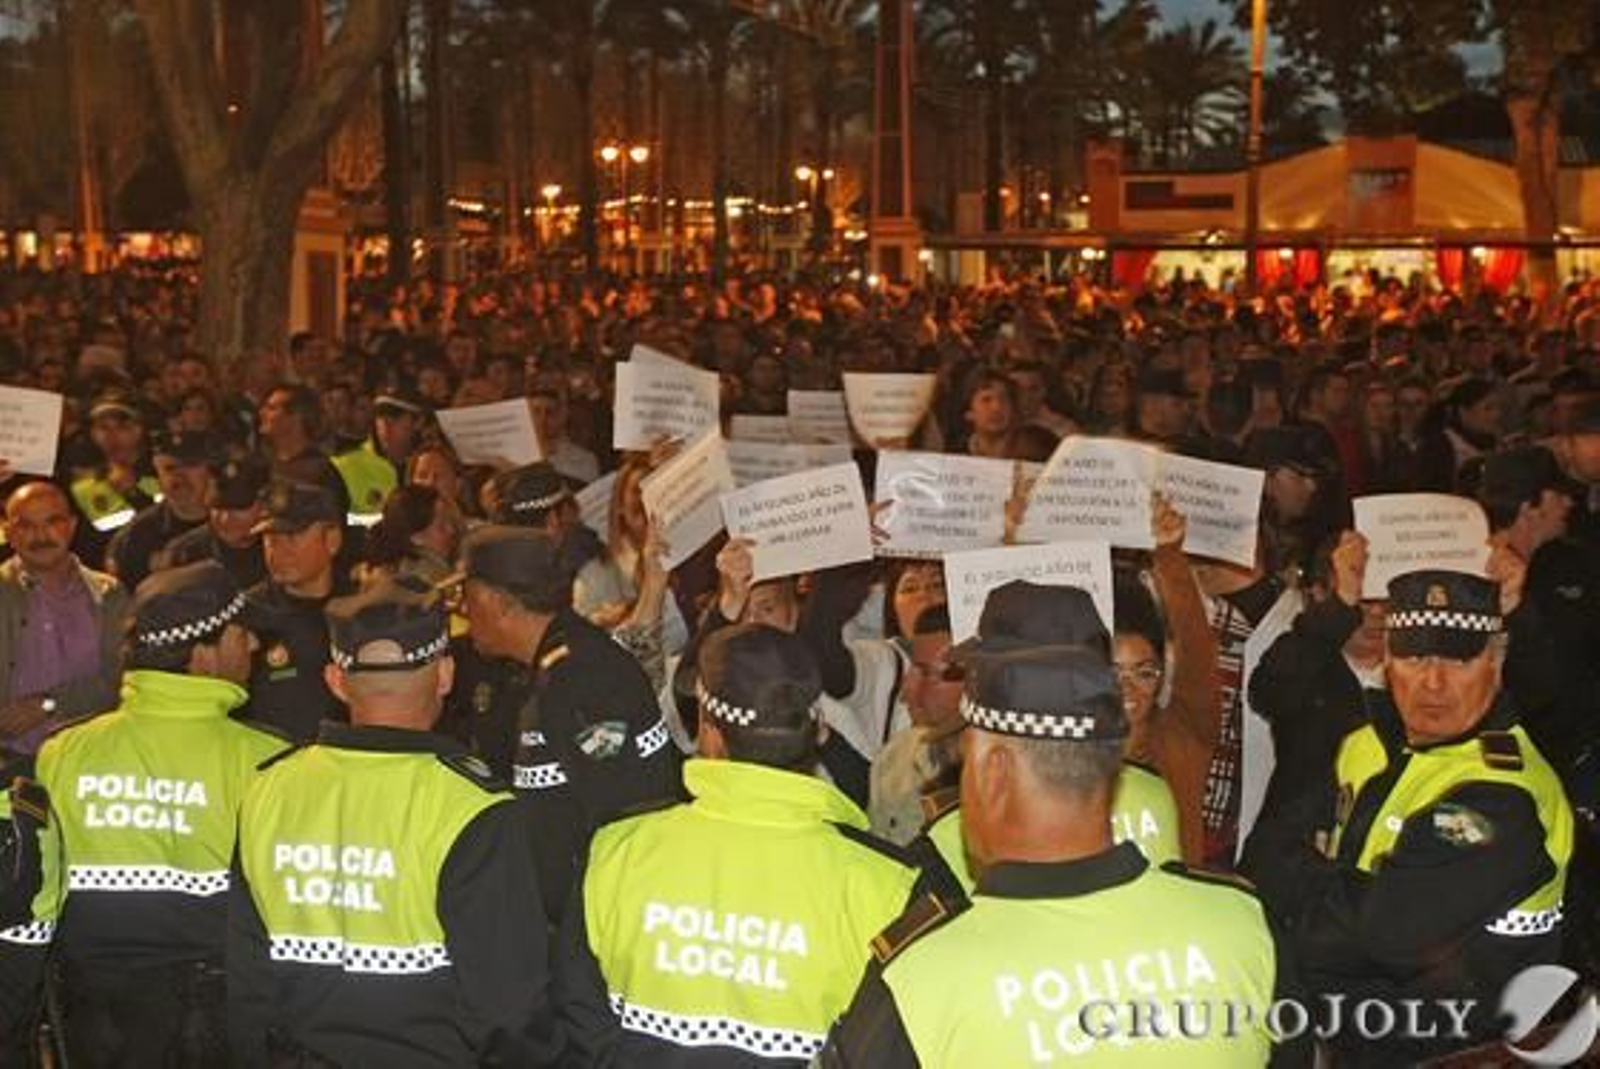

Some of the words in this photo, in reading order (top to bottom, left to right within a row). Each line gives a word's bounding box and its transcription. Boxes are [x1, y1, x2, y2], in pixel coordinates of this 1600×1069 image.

[76, 774, 208, 807] POLICIA
[84, 802, 194, 835] LOCAL
[273, 843, 397, 879] POLCIA
[643, 900, 808, 958] POLICIA
[654, 939, 789, 991] LOCAL
[995, 942, 1217, 1019] POLICIA
